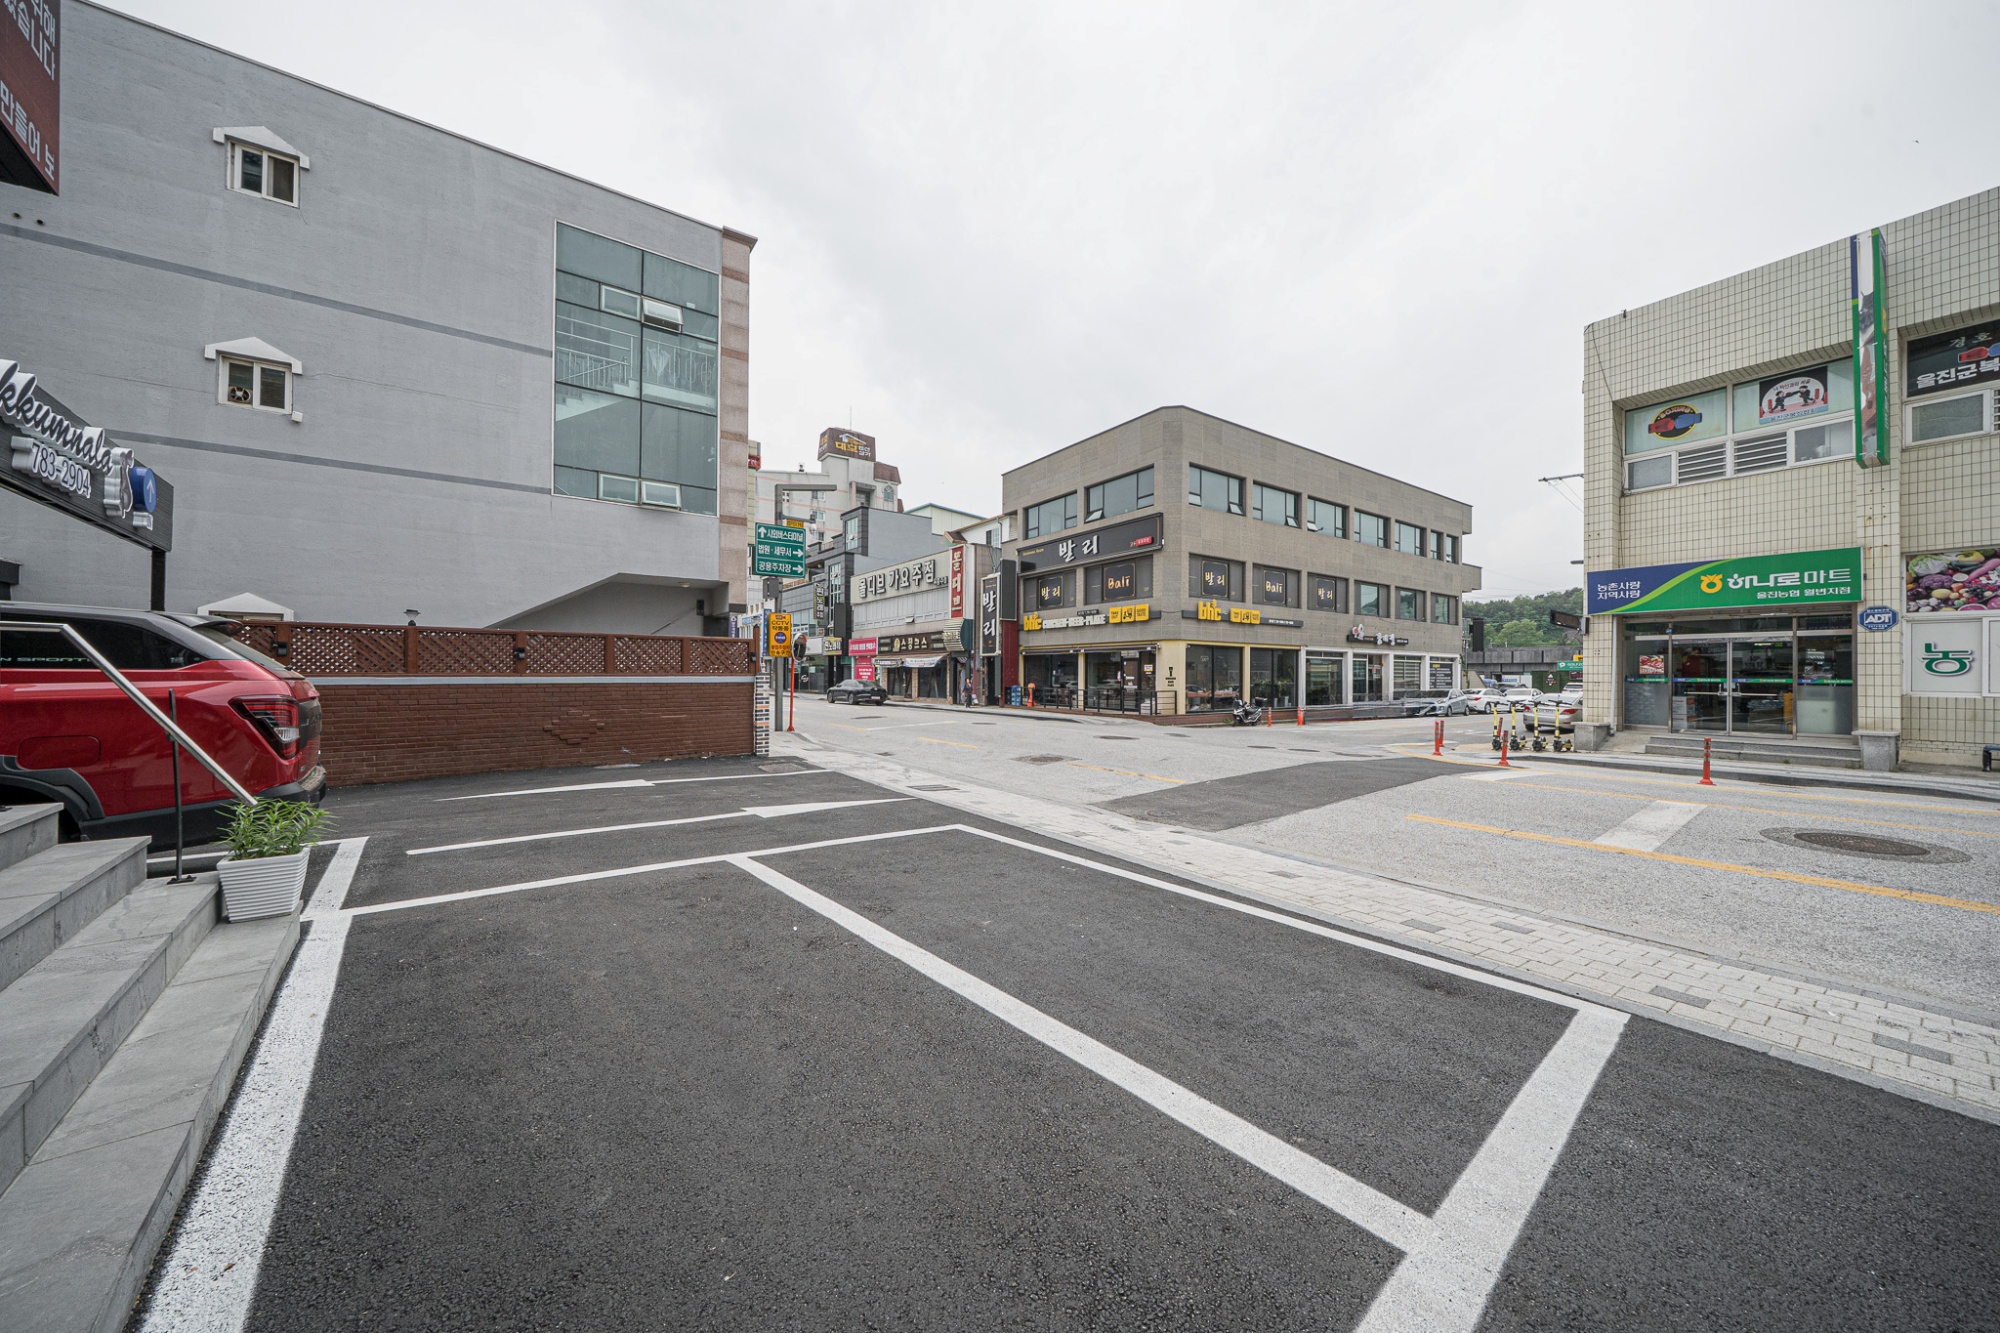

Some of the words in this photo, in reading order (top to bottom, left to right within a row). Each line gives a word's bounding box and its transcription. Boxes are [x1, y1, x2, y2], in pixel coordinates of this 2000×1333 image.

[0, 80, 41, 162] 만들어
[31, 441, 91, 498] 783-2904
[1059, 535, 1098, 562] 발리
[858, 572, 886, 599] 몰디브
[889, 559, 936, 591] 가요주점
[952, 551, 963, 611] 몰디브
[1205, 571, 1225, 587] 발리
[1597, 580, 1641, 592] 농촌사랑
[1727, 568, 1852, 590] 하나로마트
[1041, 585, 1061, 601] 발리
[1597, 590, 1641, 600] 지역사랑
[1757, 589, 1801, 600] 울진농협
[982, 590, 997, 637] 발리
[1198, 599, 1222, 621] bhc
[1864, 613, 1892, 624] ADT
[1921, 643, 1973, 675] 농
